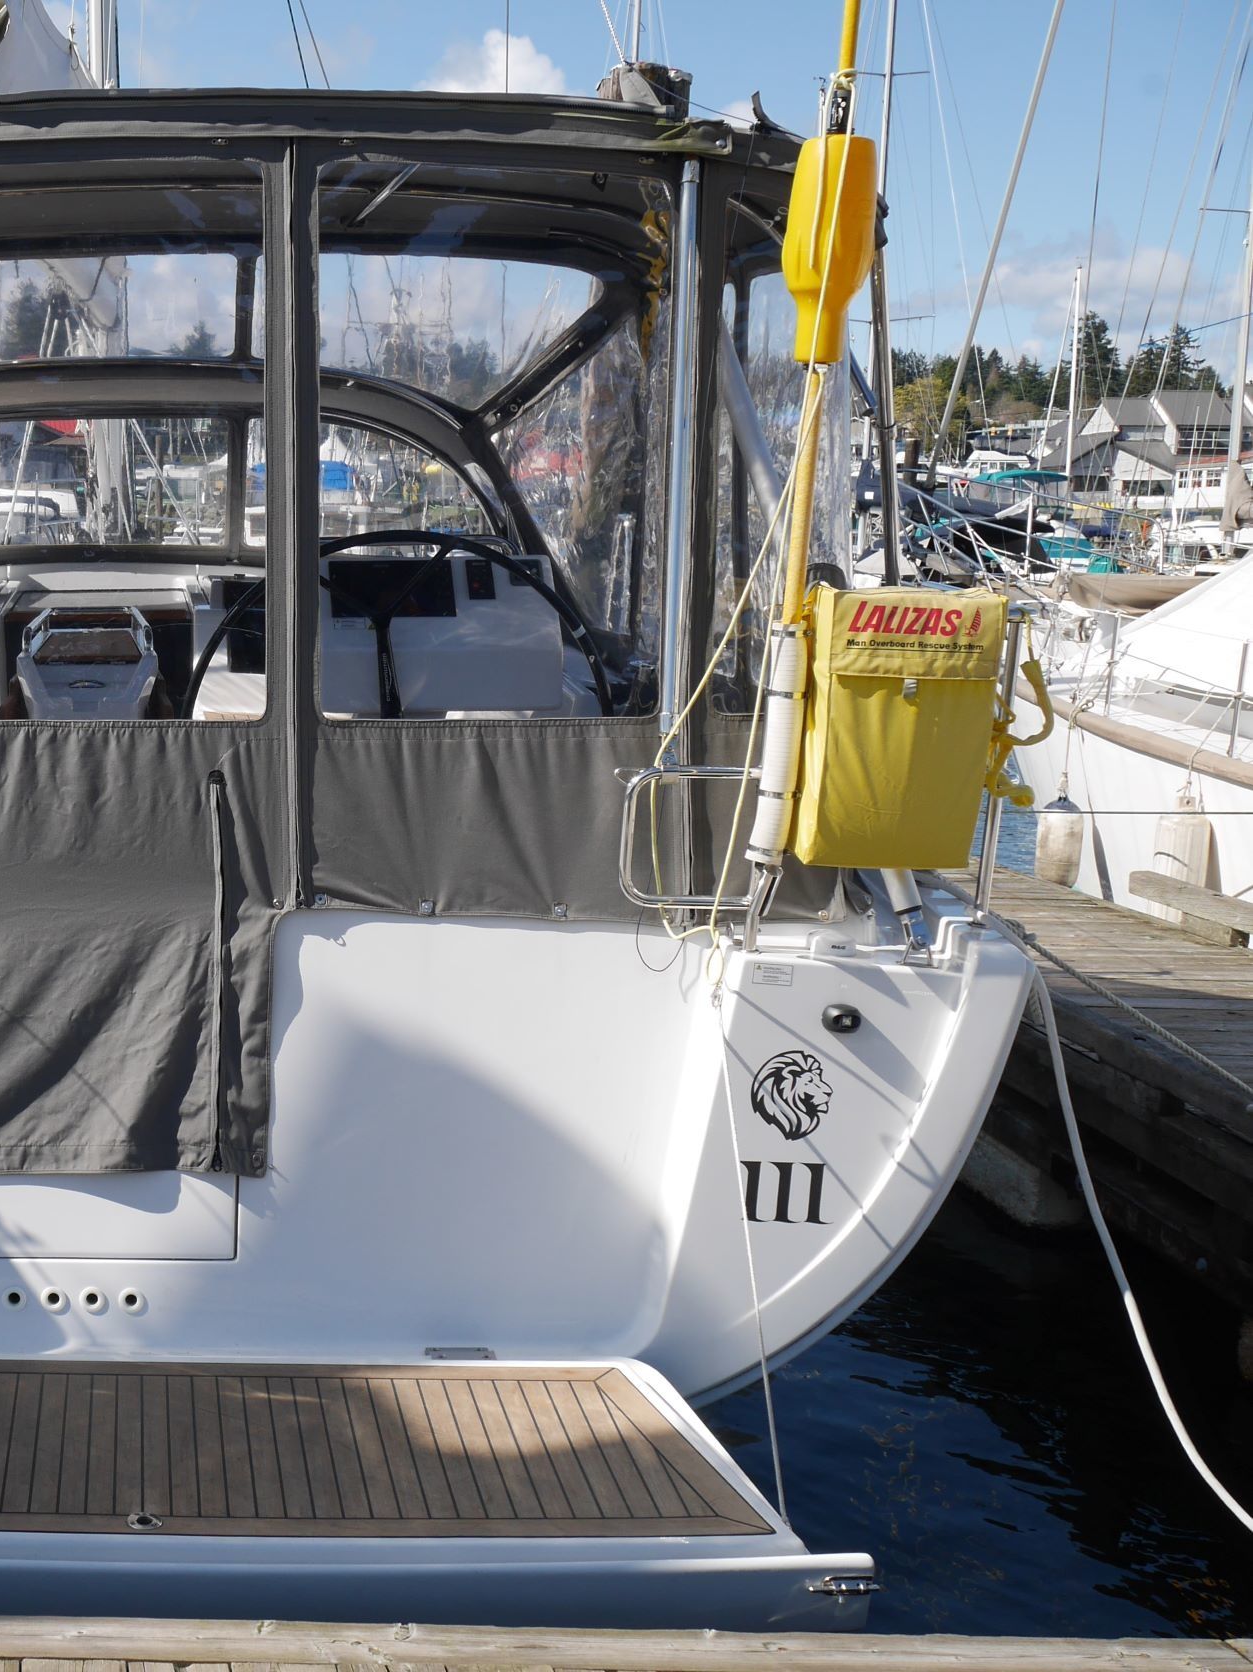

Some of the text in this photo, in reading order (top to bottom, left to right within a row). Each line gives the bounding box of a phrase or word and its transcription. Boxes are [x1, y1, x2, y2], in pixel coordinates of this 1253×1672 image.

[848, 600, 963, 637] LALIZAS
[846, 639, 984, 651] Man Overboard Rescue System
